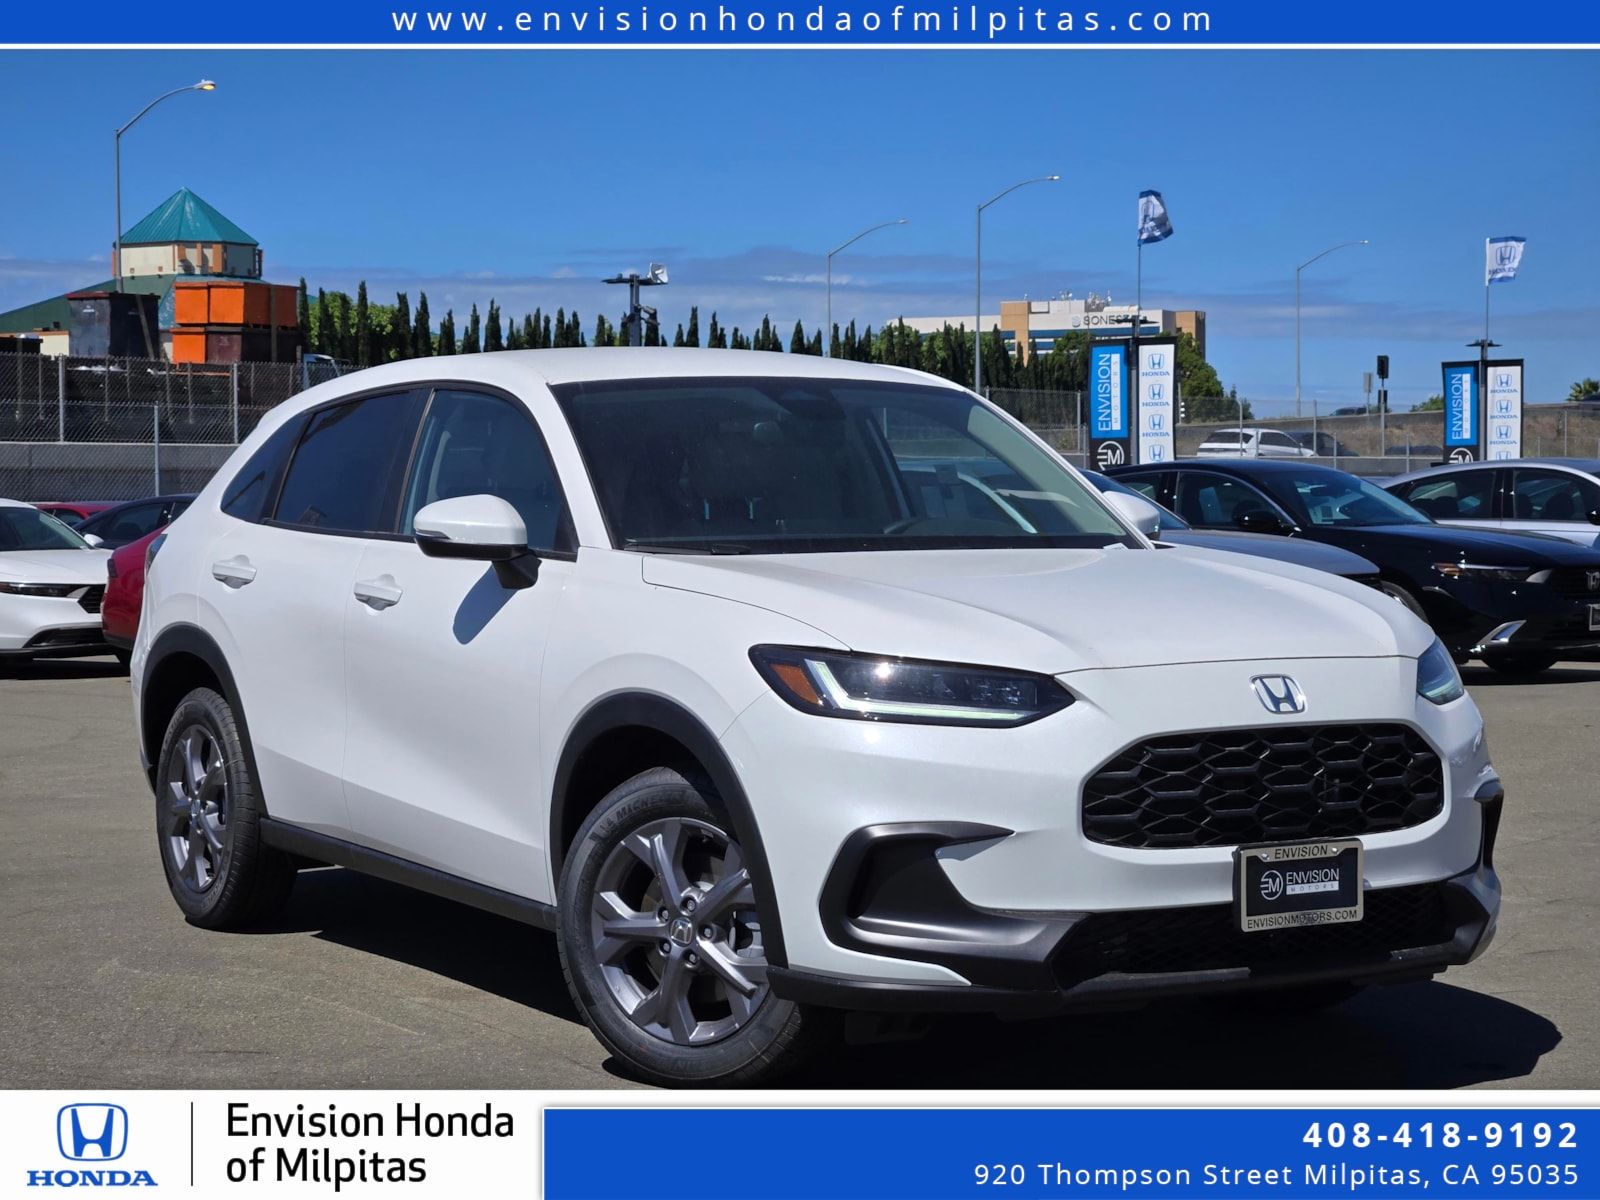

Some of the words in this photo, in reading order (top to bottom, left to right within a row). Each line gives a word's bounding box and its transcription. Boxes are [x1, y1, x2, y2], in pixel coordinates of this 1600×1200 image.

[1098, 353, 1111, 431] ENVISION
[1451, 373, 1462, 440] ENVISION
[1274, 845, 1328, 859] ENVISION
[1286, 868, 1339, 885] ENVISION
[1290, 883, 1335, 893] MOTORS
[1247, 910, 1358, 929] ENVISIONMOTORS.COM
